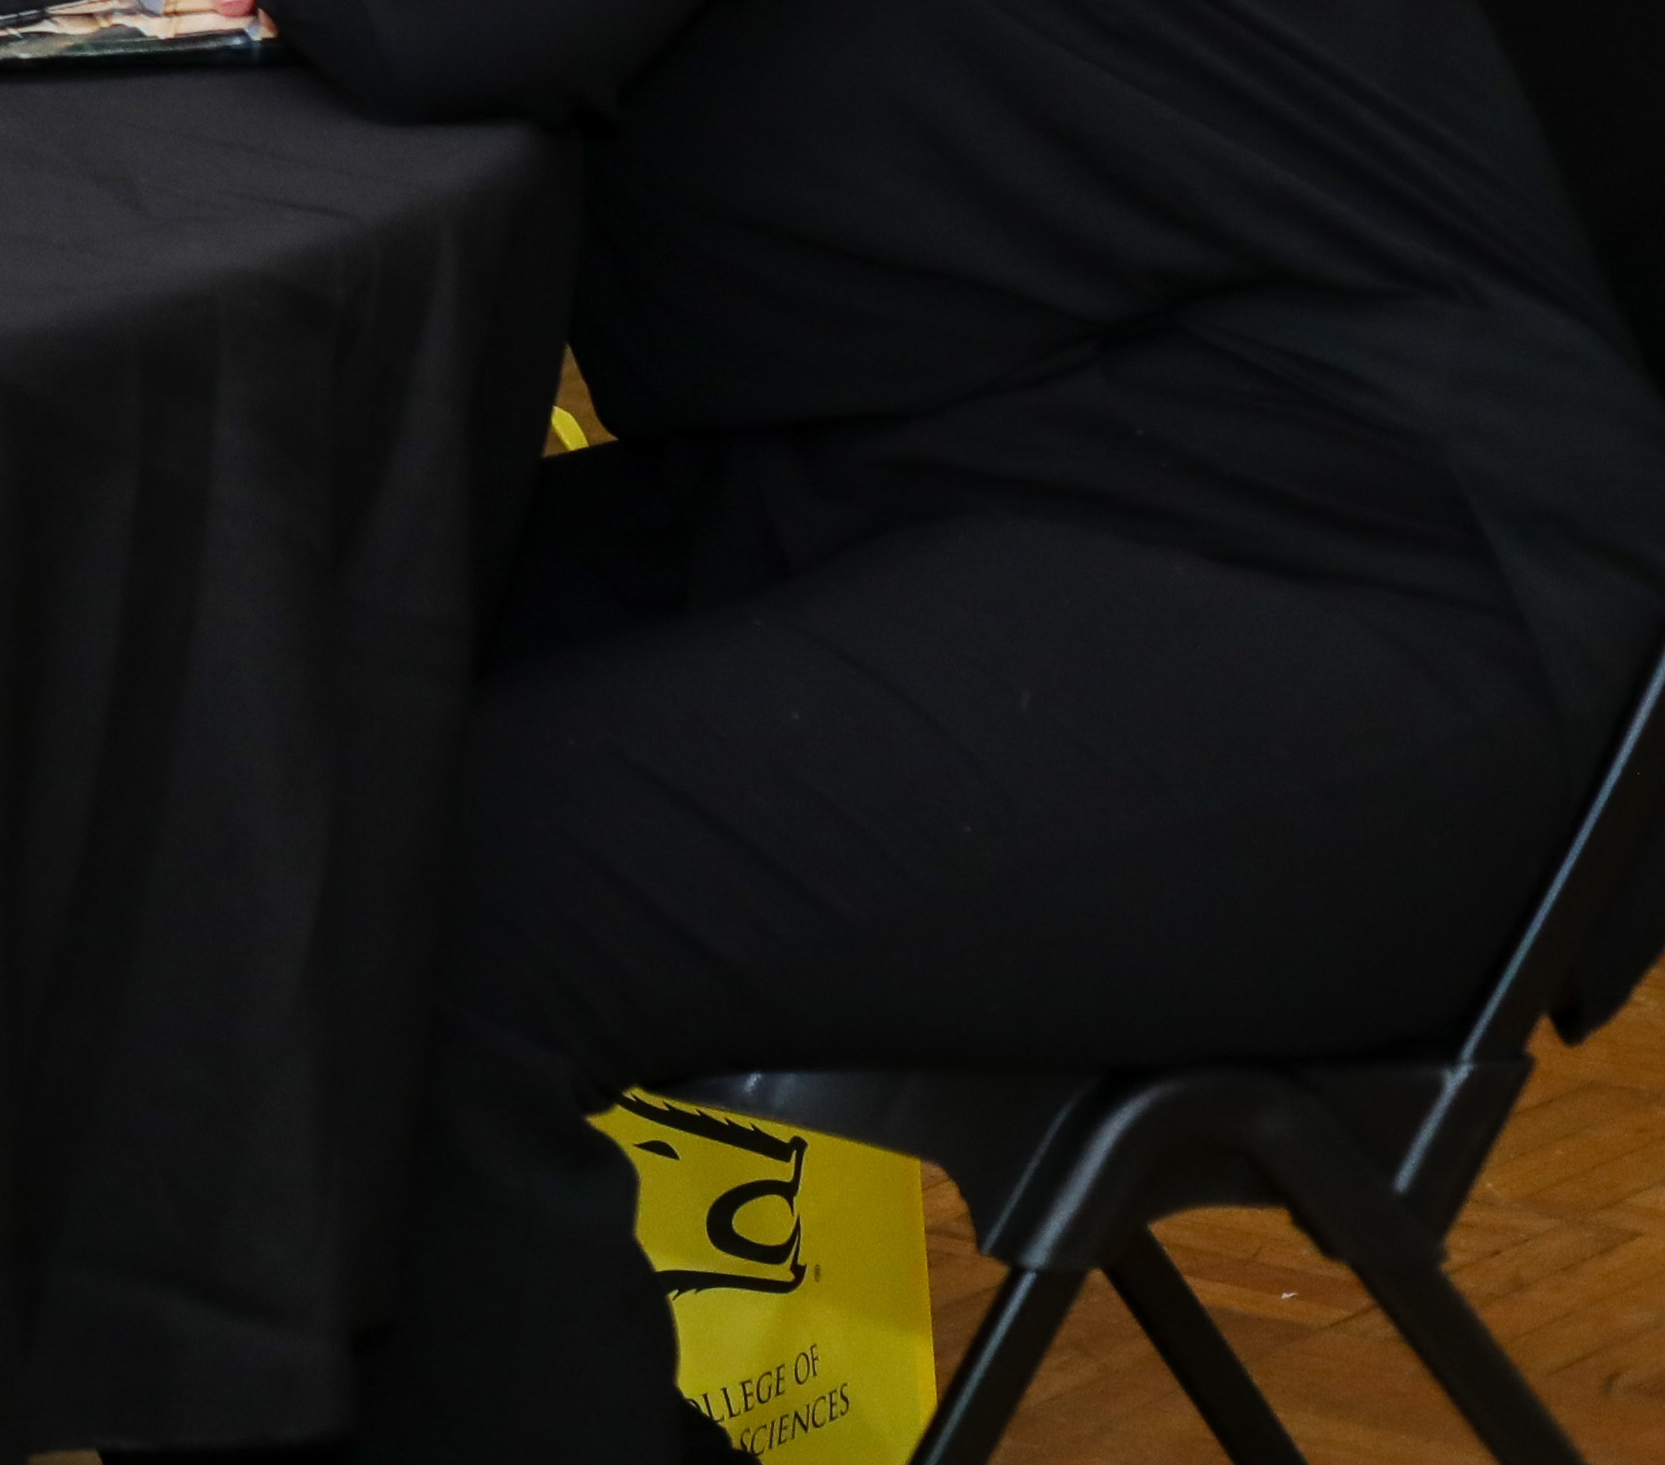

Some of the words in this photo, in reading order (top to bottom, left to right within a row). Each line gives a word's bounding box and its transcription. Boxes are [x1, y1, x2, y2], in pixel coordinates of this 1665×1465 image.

[685, 1364, 786, 1423] LLEGE
[794, 1343, 820, 1386] OF
[739, 1382, 851, 1457] SCIENCES
